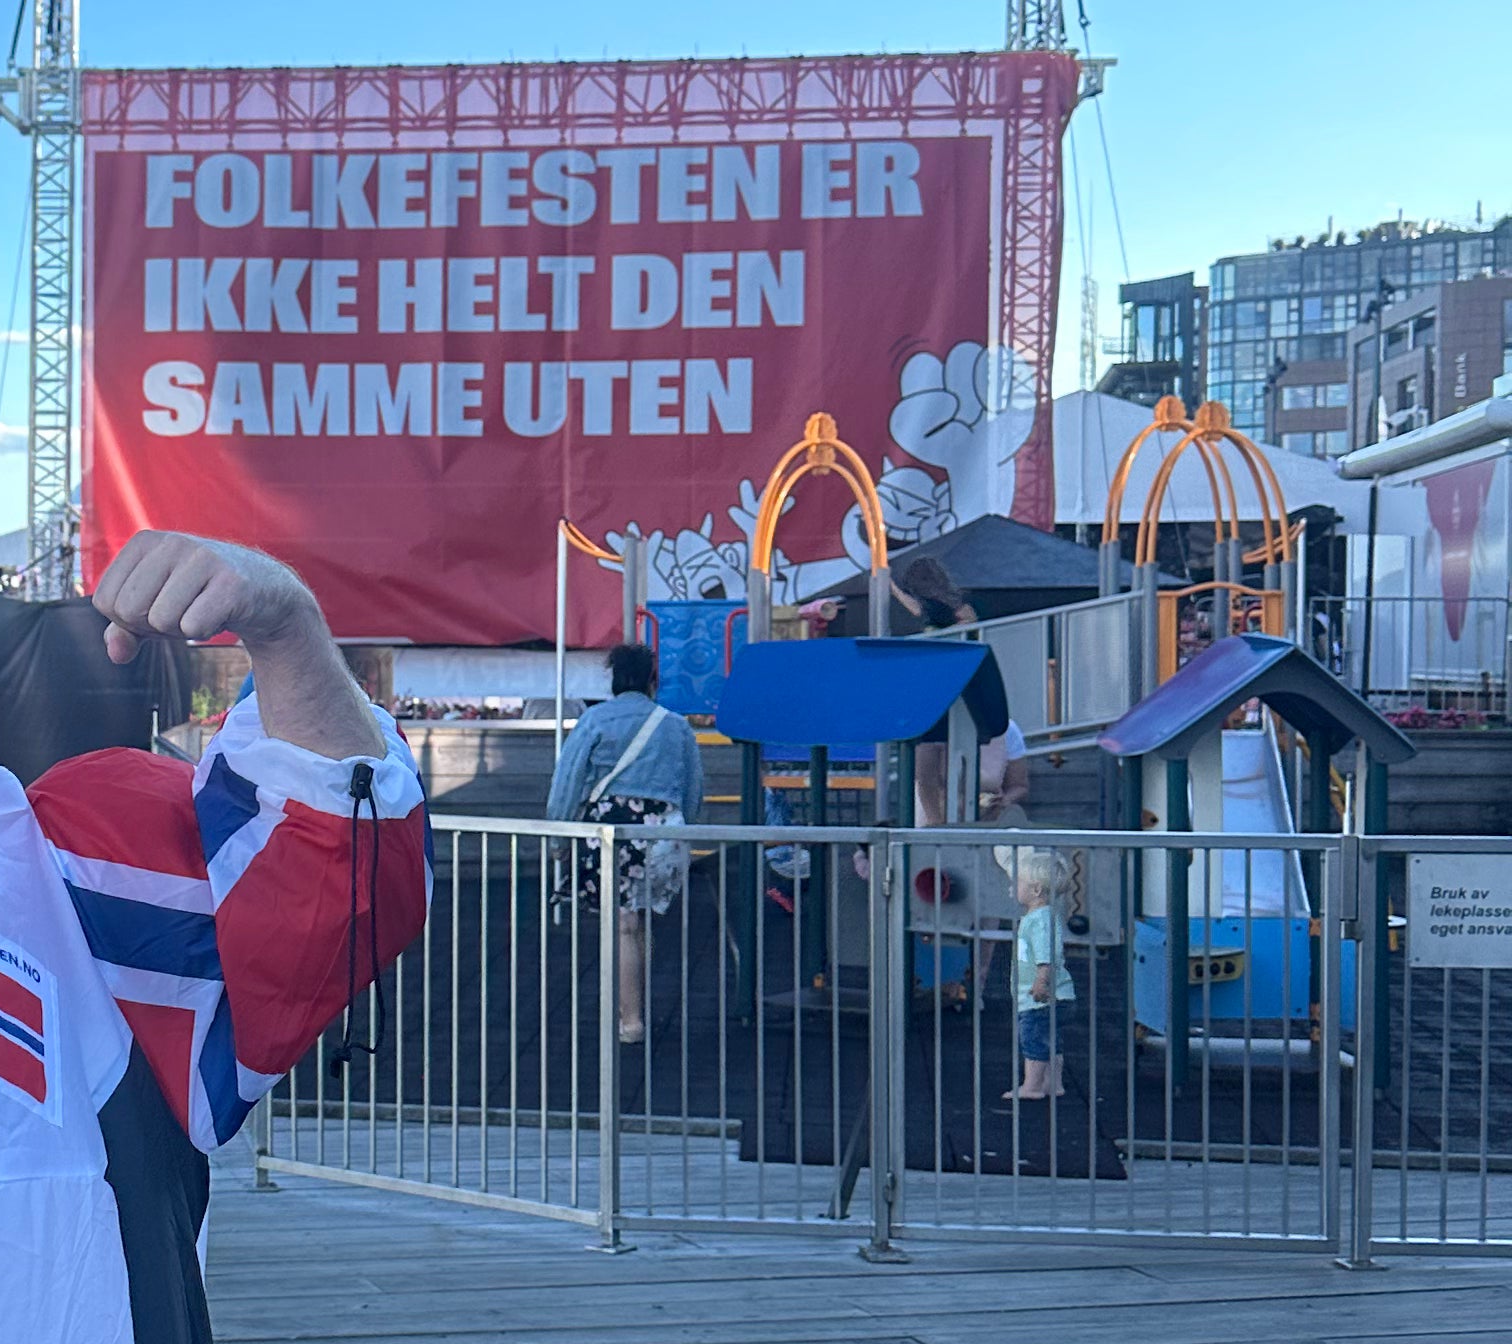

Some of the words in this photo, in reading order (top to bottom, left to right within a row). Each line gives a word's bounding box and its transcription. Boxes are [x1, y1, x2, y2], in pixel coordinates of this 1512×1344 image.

[144, 144, 781, 230] FOLKEFESTEN
[800, 141, 924, 220] ER
[143, 257, 359, 334] IKKE
[377, 255, 596, 334] HELT
[610, 250, 805, 331] DEN
[141, 360, 485, 438] SAMME
[503, 357, 753, 438] UTEN
[1430, 886, 1467, 899] Bruk
[1471, 889, 1490, 899] av
[1430, 923, 1464, 937] eget
